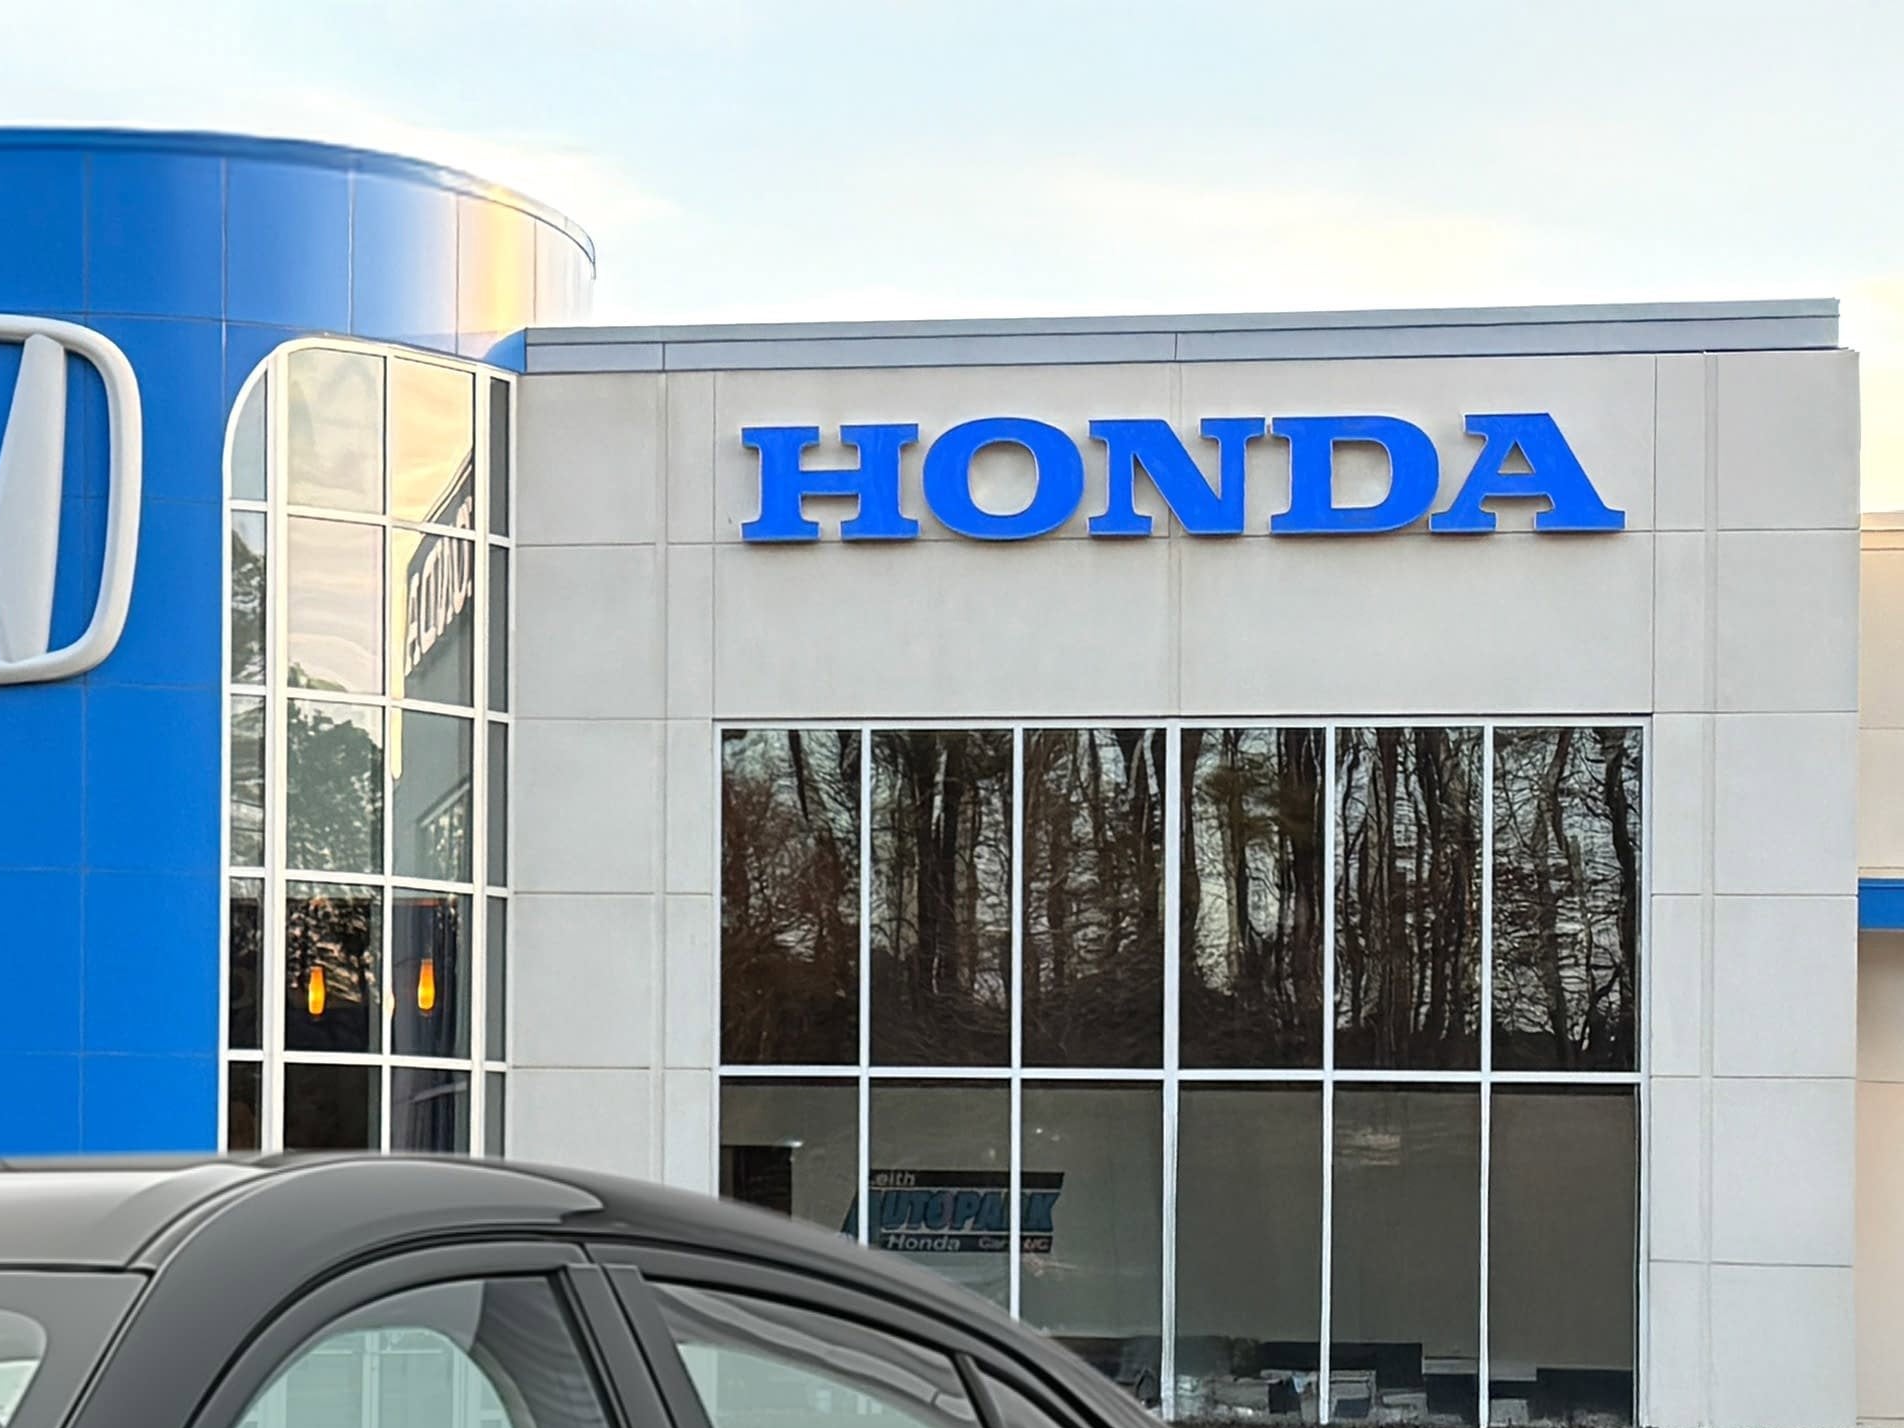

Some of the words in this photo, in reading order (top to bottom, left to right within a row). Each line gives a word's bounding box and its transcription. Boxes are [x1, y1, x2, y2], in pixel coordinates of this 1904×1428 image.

[740, 412, 1626, 542] HONDA
[869, 1172, 916, 1187] eith
[887, 1234, 961, 1251] Honda
